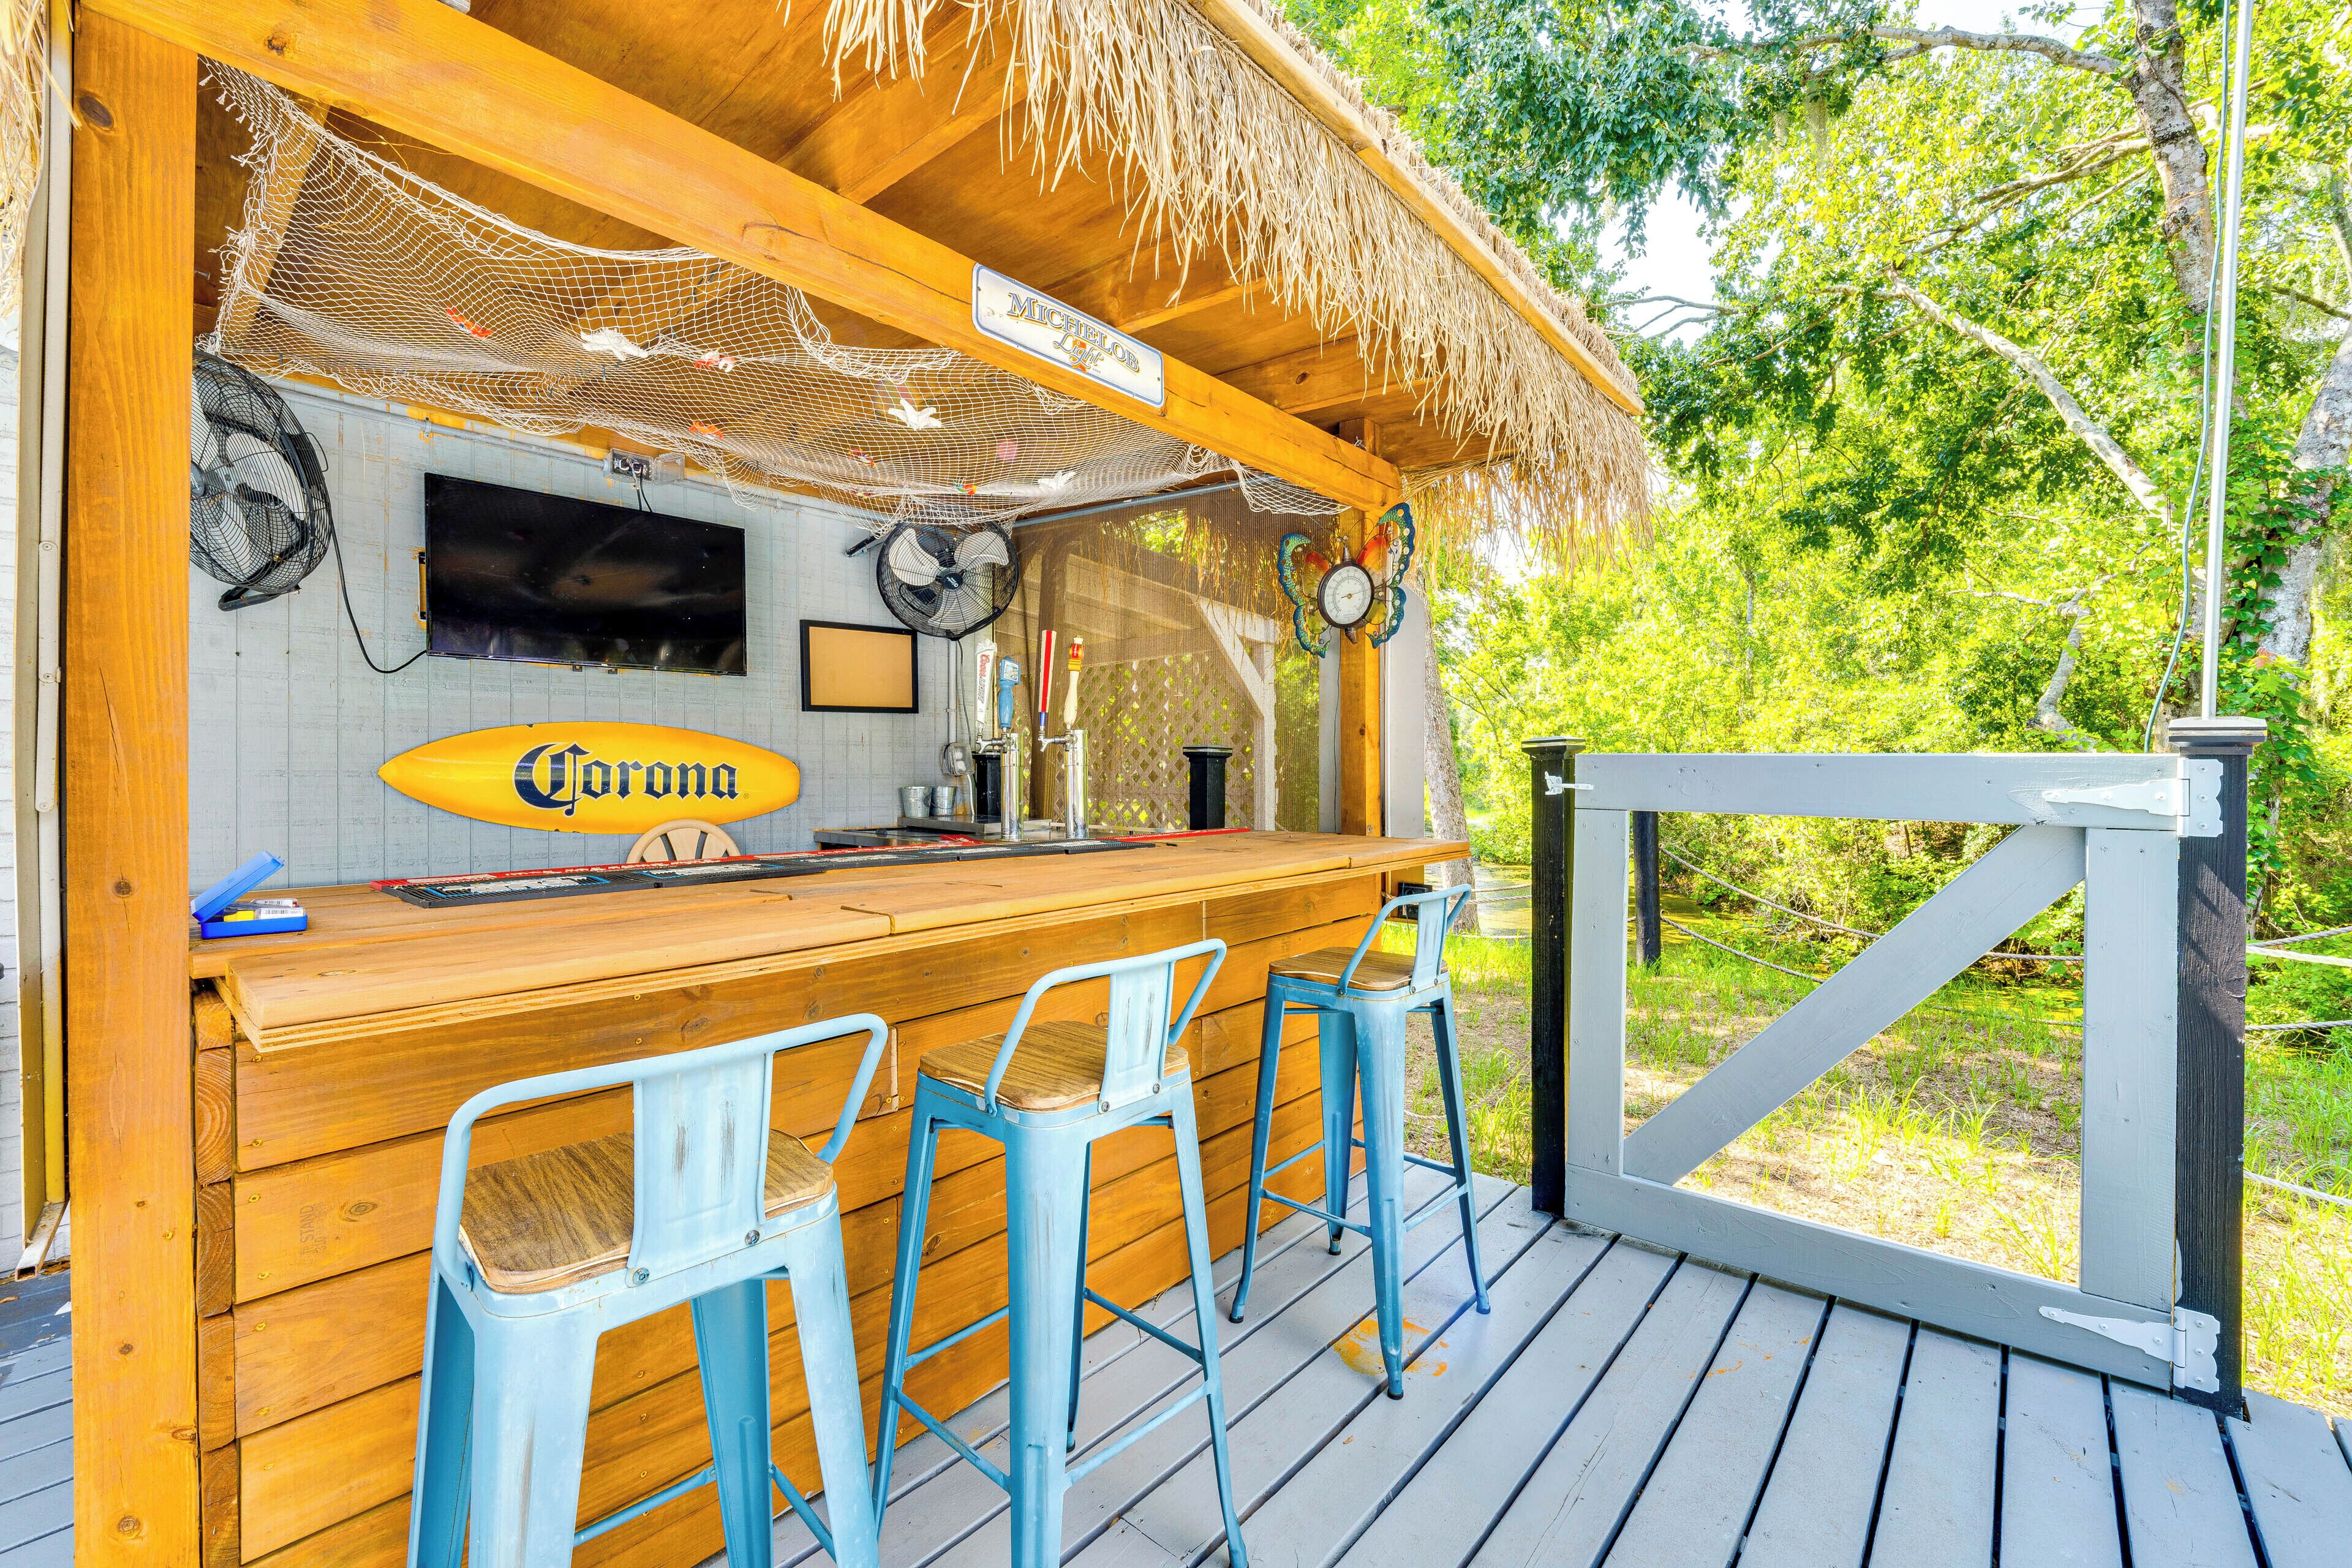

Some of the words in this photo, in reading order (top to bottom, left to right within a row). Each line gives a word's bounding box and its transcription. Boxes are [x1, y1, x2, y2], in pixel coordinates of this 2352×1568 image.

[1006, 292, 1140, 374] MICHELOB
[1052, 331, 1104, 369] Light
[979, 654, 990, 677] Coors
[512, 741, 740, 817] Corona
[300, 1205, 314, 1243] STAND
